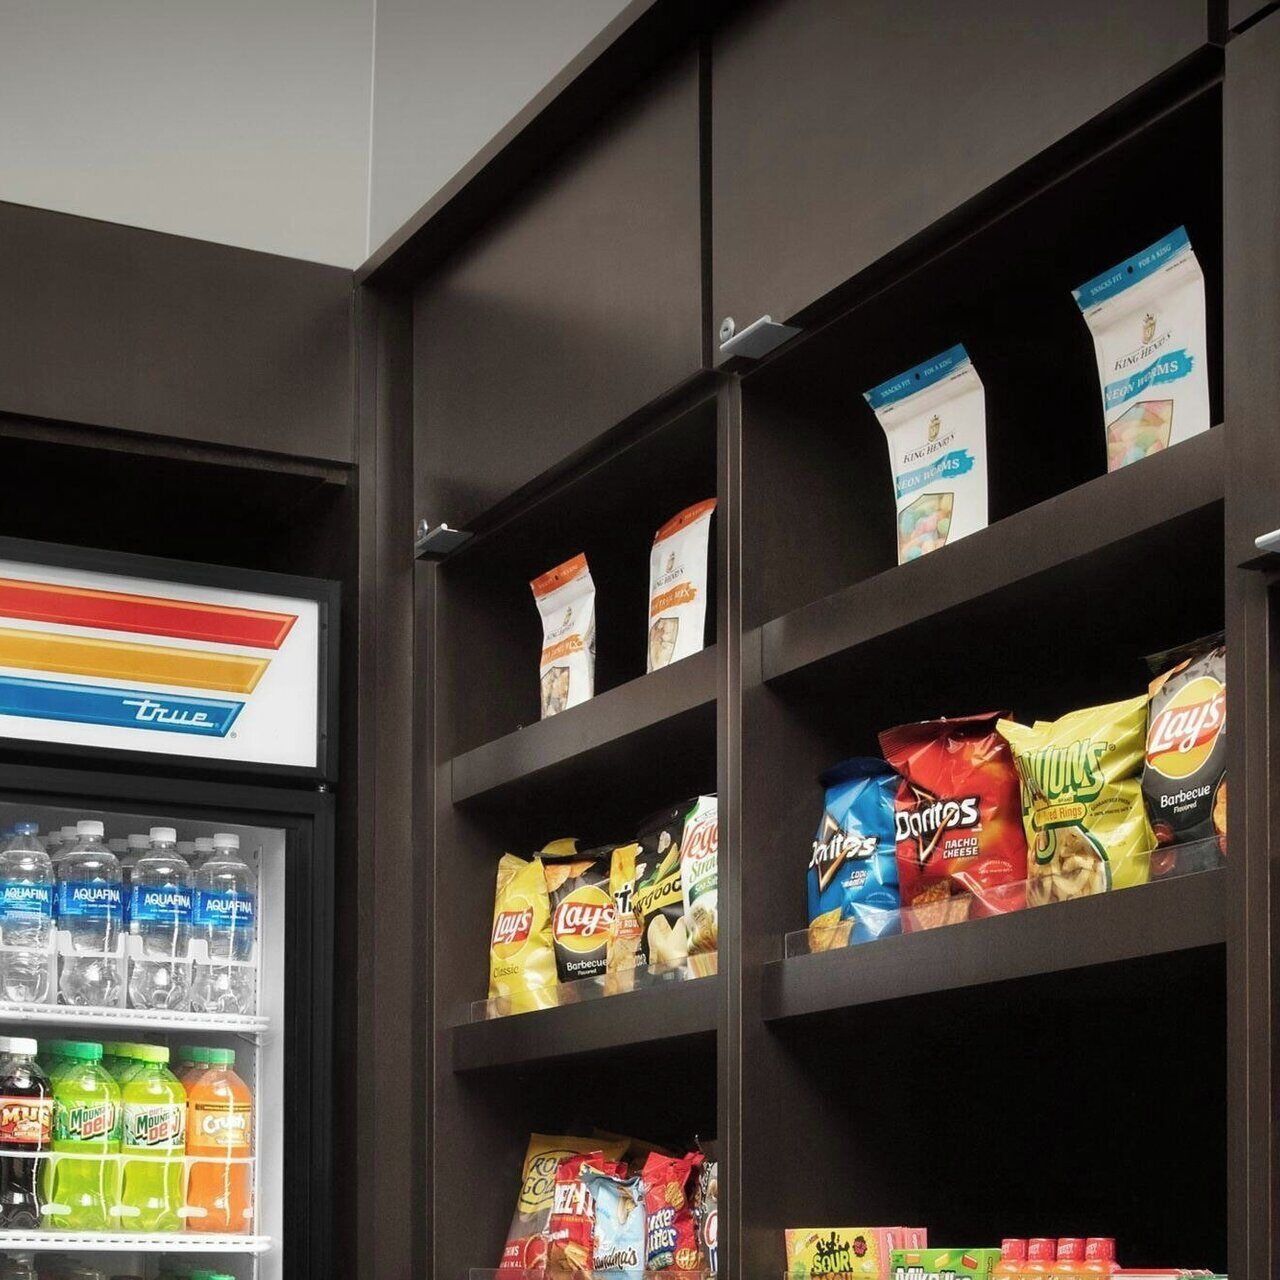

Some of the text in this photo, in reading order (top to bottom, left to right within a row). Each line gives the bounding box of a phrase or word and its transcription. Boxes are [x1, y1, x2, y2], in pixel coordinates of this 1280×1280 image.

[924, 457, 960, 480] WORMS
[1148, 696, 1225, 753] Lay's
[1161, 784, 1210, 808] Barbecue
[1059, 807, 1082, 818] Rings
[1174, 801, 1197, 814] Flavored
[895, 798, 977, 841] Doritos
[945, 838, 978, 849] NACHO
[943, 846, 978, 858] CHEESE
[74, 887, 120, 902] AQUAFINA
[206, 899, 252, 914] AQUAFINA
[556, 901, 616, 936] Lay's
[493, 909, 533, 945] Lay's
[493, 965, 519, 978] Classic
[567, 959, 608, 971] Barbecue
[812, 1251, 850, 1272] SOUR
